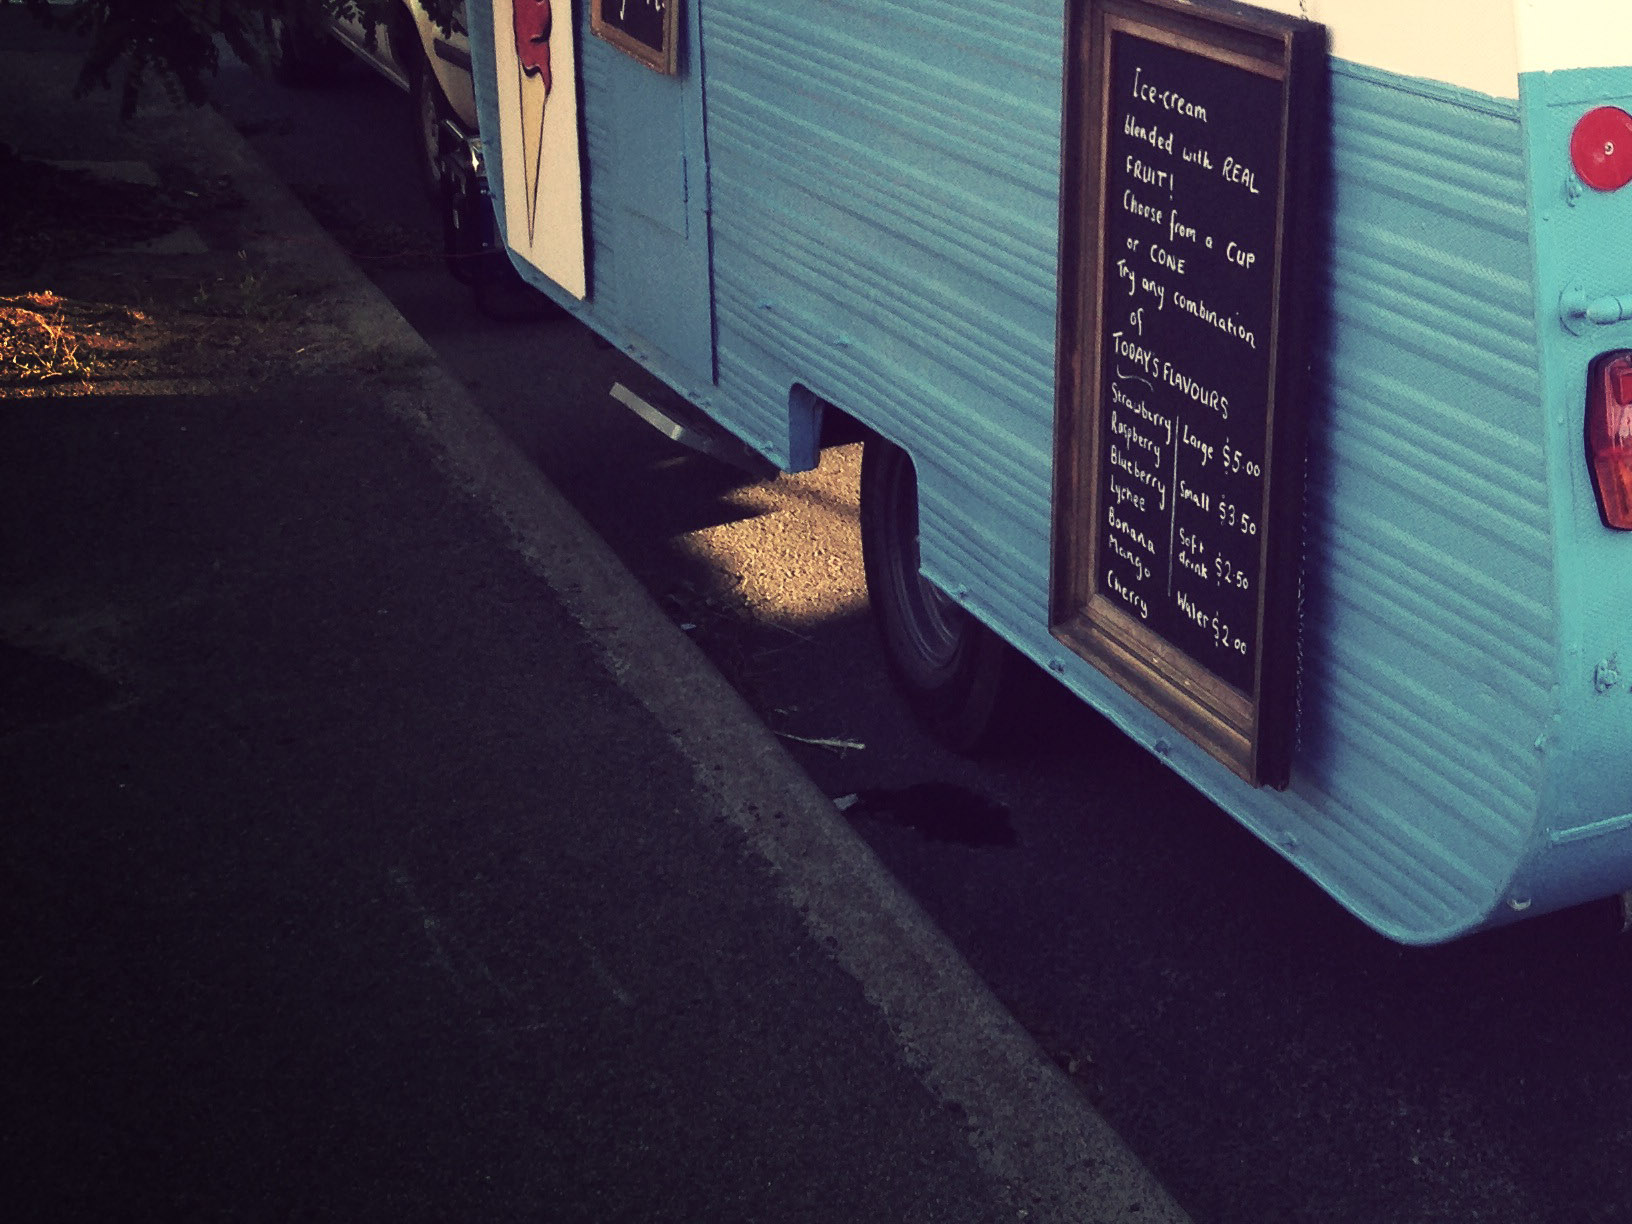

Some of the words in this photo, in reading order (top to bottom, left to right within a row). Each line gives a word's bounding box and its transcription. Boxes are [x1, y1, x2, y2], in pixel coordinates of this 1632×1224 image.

[1133, 67, 1208, 123] Ice-cream
[1124, 114, 1172, 157] blended
[1181, 148, 1213, 171] with
[1222, 157, 1259, 195] REAL
[1125, 155, 1174, 201] FRUIT!
[1123, 189, 1162, 225] Choose
[1169, 210, 1197, 243] from
[1205, 236, 1213, 250] a
[1226, 243, 1256, 271] CUP
[1127, 238, 1138, 251] or
[1150, 244, 1185, 274] CONE
[1117, 259, 1135, 296] Try
[1143, 278, 1165, 311] any
[1173, 291, 1256, 349] combination
[1130, 308, 1144, 336] of
[1163, 362, 1228, 419] FLAVOURS
[1111, 411, 1160, 468] Raspberry
[1183, 425, 1213, 466] Large
[1223, 437, 1260, 476] $5.00
[1110, 445, 1165, 510] Blueberry
[1110, 475, 1145, 512] Lychee
[1180, 480, 1209, 511] Small
[1179, 527, 1203, 554] Soft
[1179, 551, 1207, 579] drink
[1108, 570, 1147, 618] Cherry
